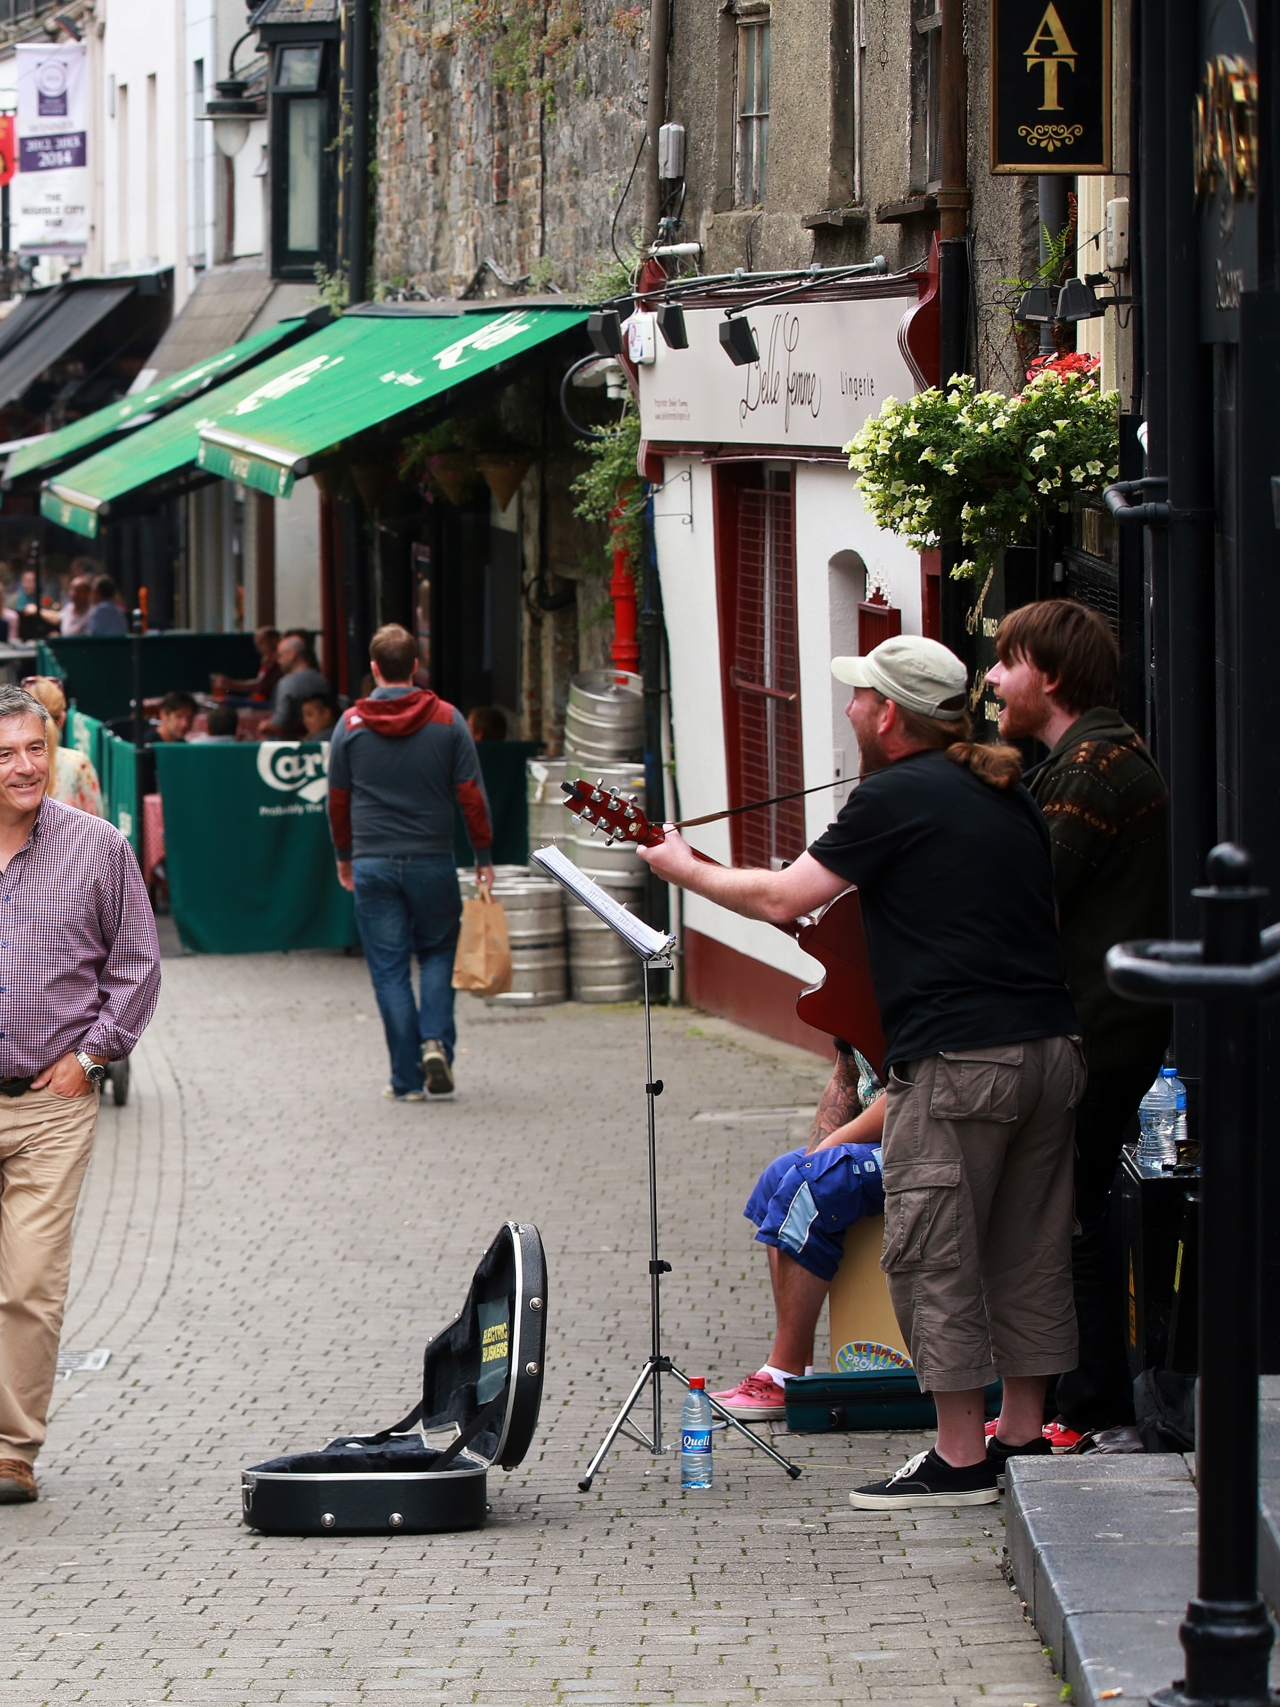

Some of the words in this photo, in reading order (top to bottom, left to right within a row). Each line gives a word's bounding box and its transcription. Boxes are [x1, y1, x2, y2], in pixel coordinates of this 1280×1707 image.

[37, 150, 73, 168] 2014
[840, 370, 875, 401] Lingerie
[259, 804, 304, 816] Probably
[306, 803, 324, 813] the
[482, 1322, 508, 1345] ELECTRIC
[482, 1341, 508, 1363] BUSKERS
[854, 1343, 868, 1353] WE
[683, 1435, 710, 1450] Quell
